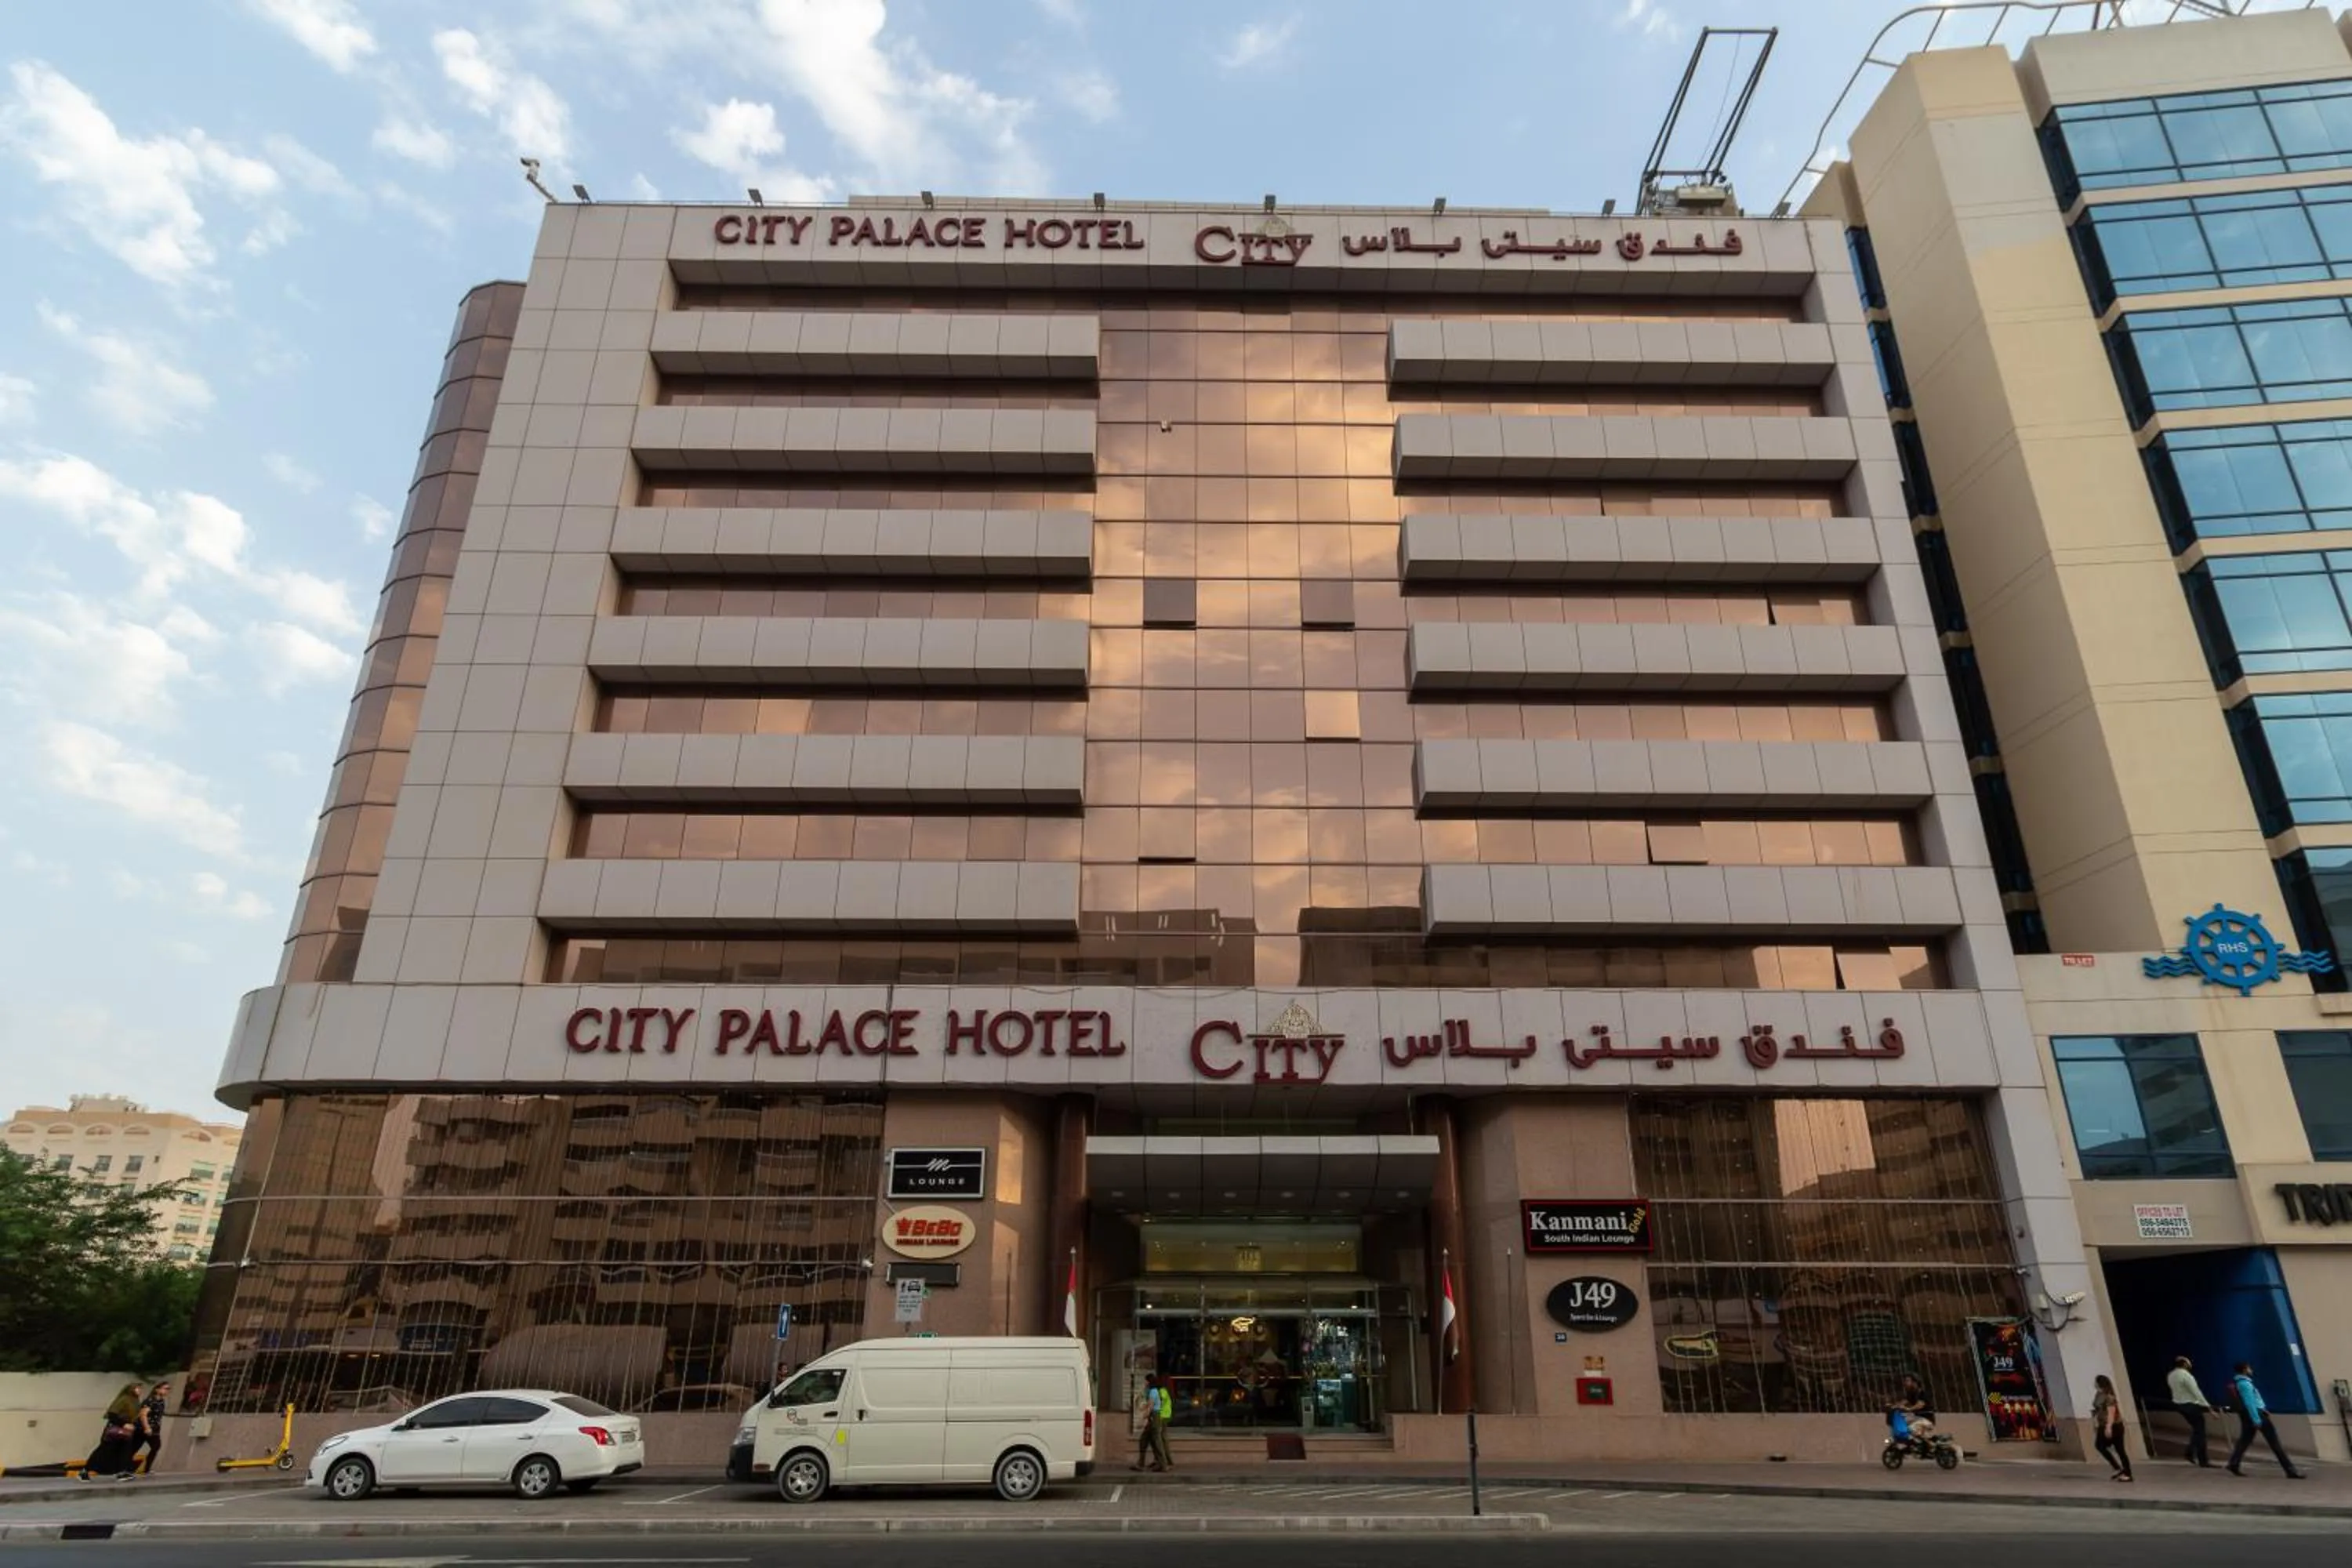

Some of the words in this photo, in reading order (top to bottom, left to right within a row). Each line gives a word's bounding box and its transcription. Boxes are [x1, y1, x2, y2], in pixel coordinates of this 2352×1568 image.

[714, 216, 813, 245] CITY
[829, 216, 986, 248] PALACE
[1004, 218, 1145, 250] HOTEL
[1342, 227, 1461, 258] بلاس
[1617, 229, 1743, 261] فندق
[2218, 942, 2249, 953] RHS
[565, 1007, 695, 1054] CITY
[715, 1008, 920, 1056] PALACE
[946, 1011, 1126, 1058] HOTEL
[1383, 1019, 1537, 1069] بلاس
[1740, 1018, 1905, 1069] فندق
[1530, 1211, 1628, 1230] Kanmani
[1628, 1207, 1646, 1233] Gold
[1544, 1233, 1570, 1243] South
[1573, 1233, 1600, 1243] Indian
[1602, 1234, 1635, 1244] Lounge
[1570, 1283, 1616, 1308] J49
